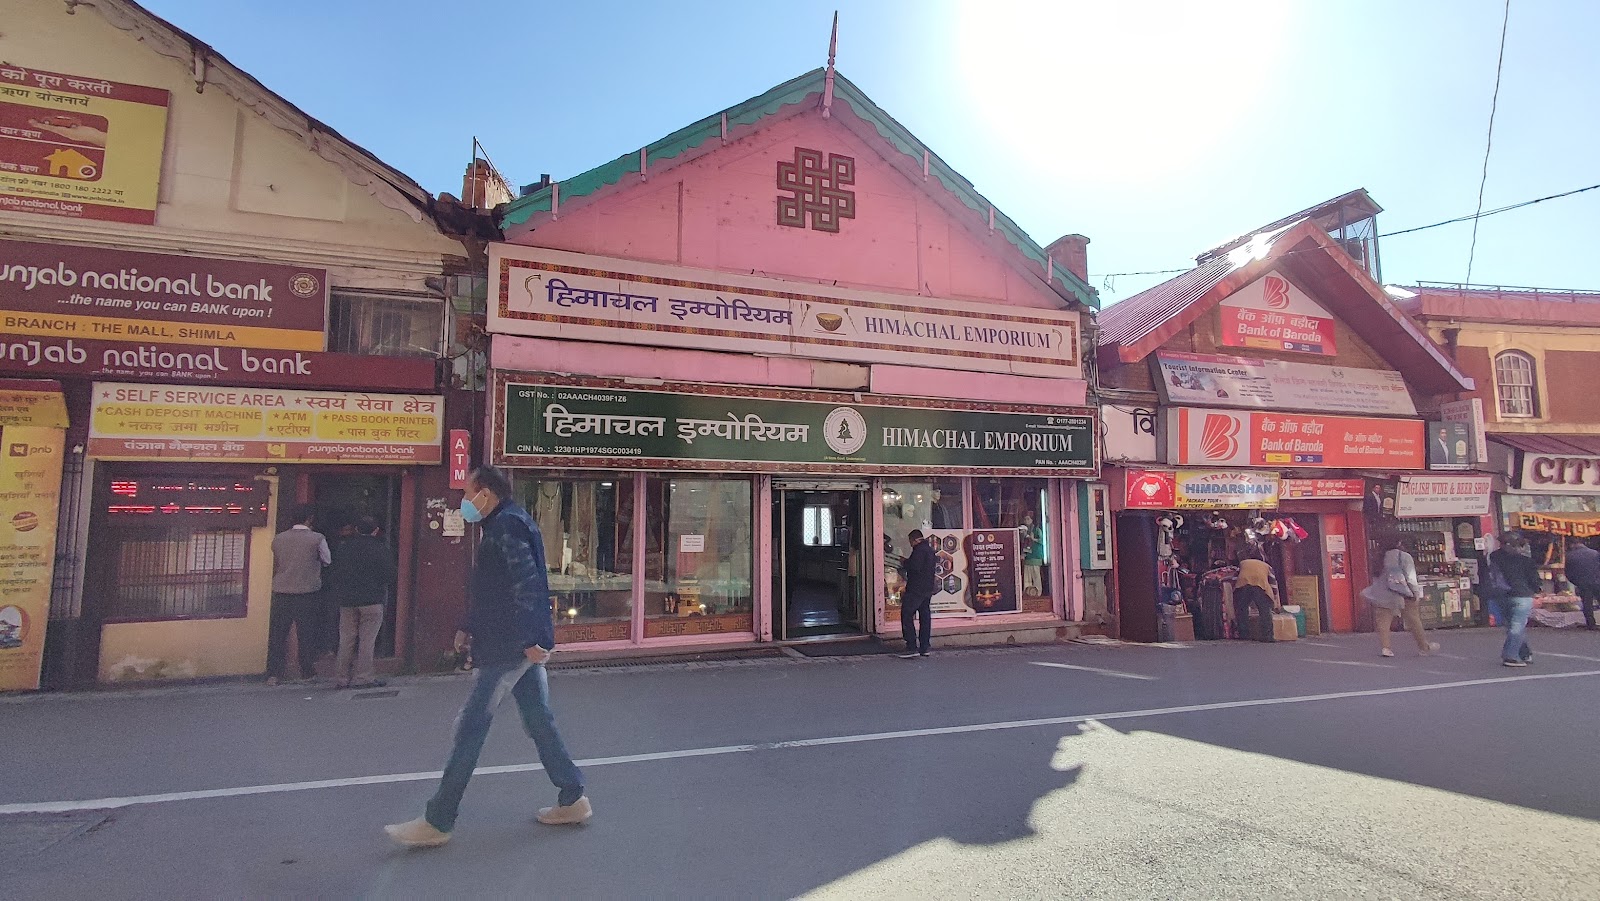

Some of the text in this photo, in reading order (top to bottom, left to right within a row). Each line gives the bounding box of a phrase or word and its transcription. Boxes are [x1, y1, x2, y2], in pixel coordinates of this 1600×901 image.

[0, 68, 114, 94] को पूरा करती
[0, 86, 31, 98] ऋण
[20, 130, 42, 139] ऋण
[50, 182, 71, 190] 1800
[20, 199, 60, 210] national
[60, 202, 83, 212] bank
[81, 268, 201, 296] national
[206, 274, 273, 302] bank
[95, 296, 132, 308] name
[135, 300, 160, 311] you
[163, 302, 187, 312] can
[190, 302, 229, 314] BANK
[232, 308, 264, 318] upon
[545, 278, 793, 325] हिमाचल इम्पोरियम
[1237, 308, 1256, 321] बैंक
[1290, 315, 1320, 330] बड़ौदा
[5, 316, 76, 331] BRANCH
[91, 322, 122, 334] THE
[178, 328, 236, 341] SHIMLA
[865, 316, 1051, 348] HIMACHAL EMPORIUM
[1237, 323, 1322, 342] Bank of Baroda
[0, 339, 311, 375] njab national bank
[1163, 363, 1248, 376] Tourist Information Center
[115, 389, 285, 407] SELF SERVICE AREA
[518, 390, 536, 398] GST
[537, 391, 550, 399] No.
[304, 394, 436, 413] स्वयं सेवा क्षेत्र
[105, 406, 262, 420] CASH DEPOSIT MACHINE
[282, 413, 307, 421] ATM
[332, 415, 435, 425] PASS BOOK PRINTER
[542, 403, 666, 438] हिमाचल
[675, 412, 809, 444] इम्पोरियम
[128, 421, 240, 433] नकद जमा मशीन
[277, 423, 311, 436] एटीएम
[1261, 417, 1276, 432] बैंक
[1302, 419, 1324, 437] बड़ौदा
[346, 428, 366, 437] पास
[371, 429, 391, 440] बुक
[882, 427, 980, 451] HIMACHAL
[983, 432, 1073, 452] EMPORIUM
[30, 445, 52, 455] pnb
[307, 444, 415, 454] punjab national bank
[1261, 438, 1324, 452] Bank of Baroda
[1344, 445, 1359, 454] Bank
[1359, 446, 1365, 454] of
[1365, 446, 1385, 455] Baroda
[455, 438, 465, 480] ATM
[1201, 473, 1252, 484] TRAVEL
[1185, 483, 1273, 494] HIMDARSHAN
[1402, 482, 1490, 495] ENGLISH WINE & BEER SHOP
